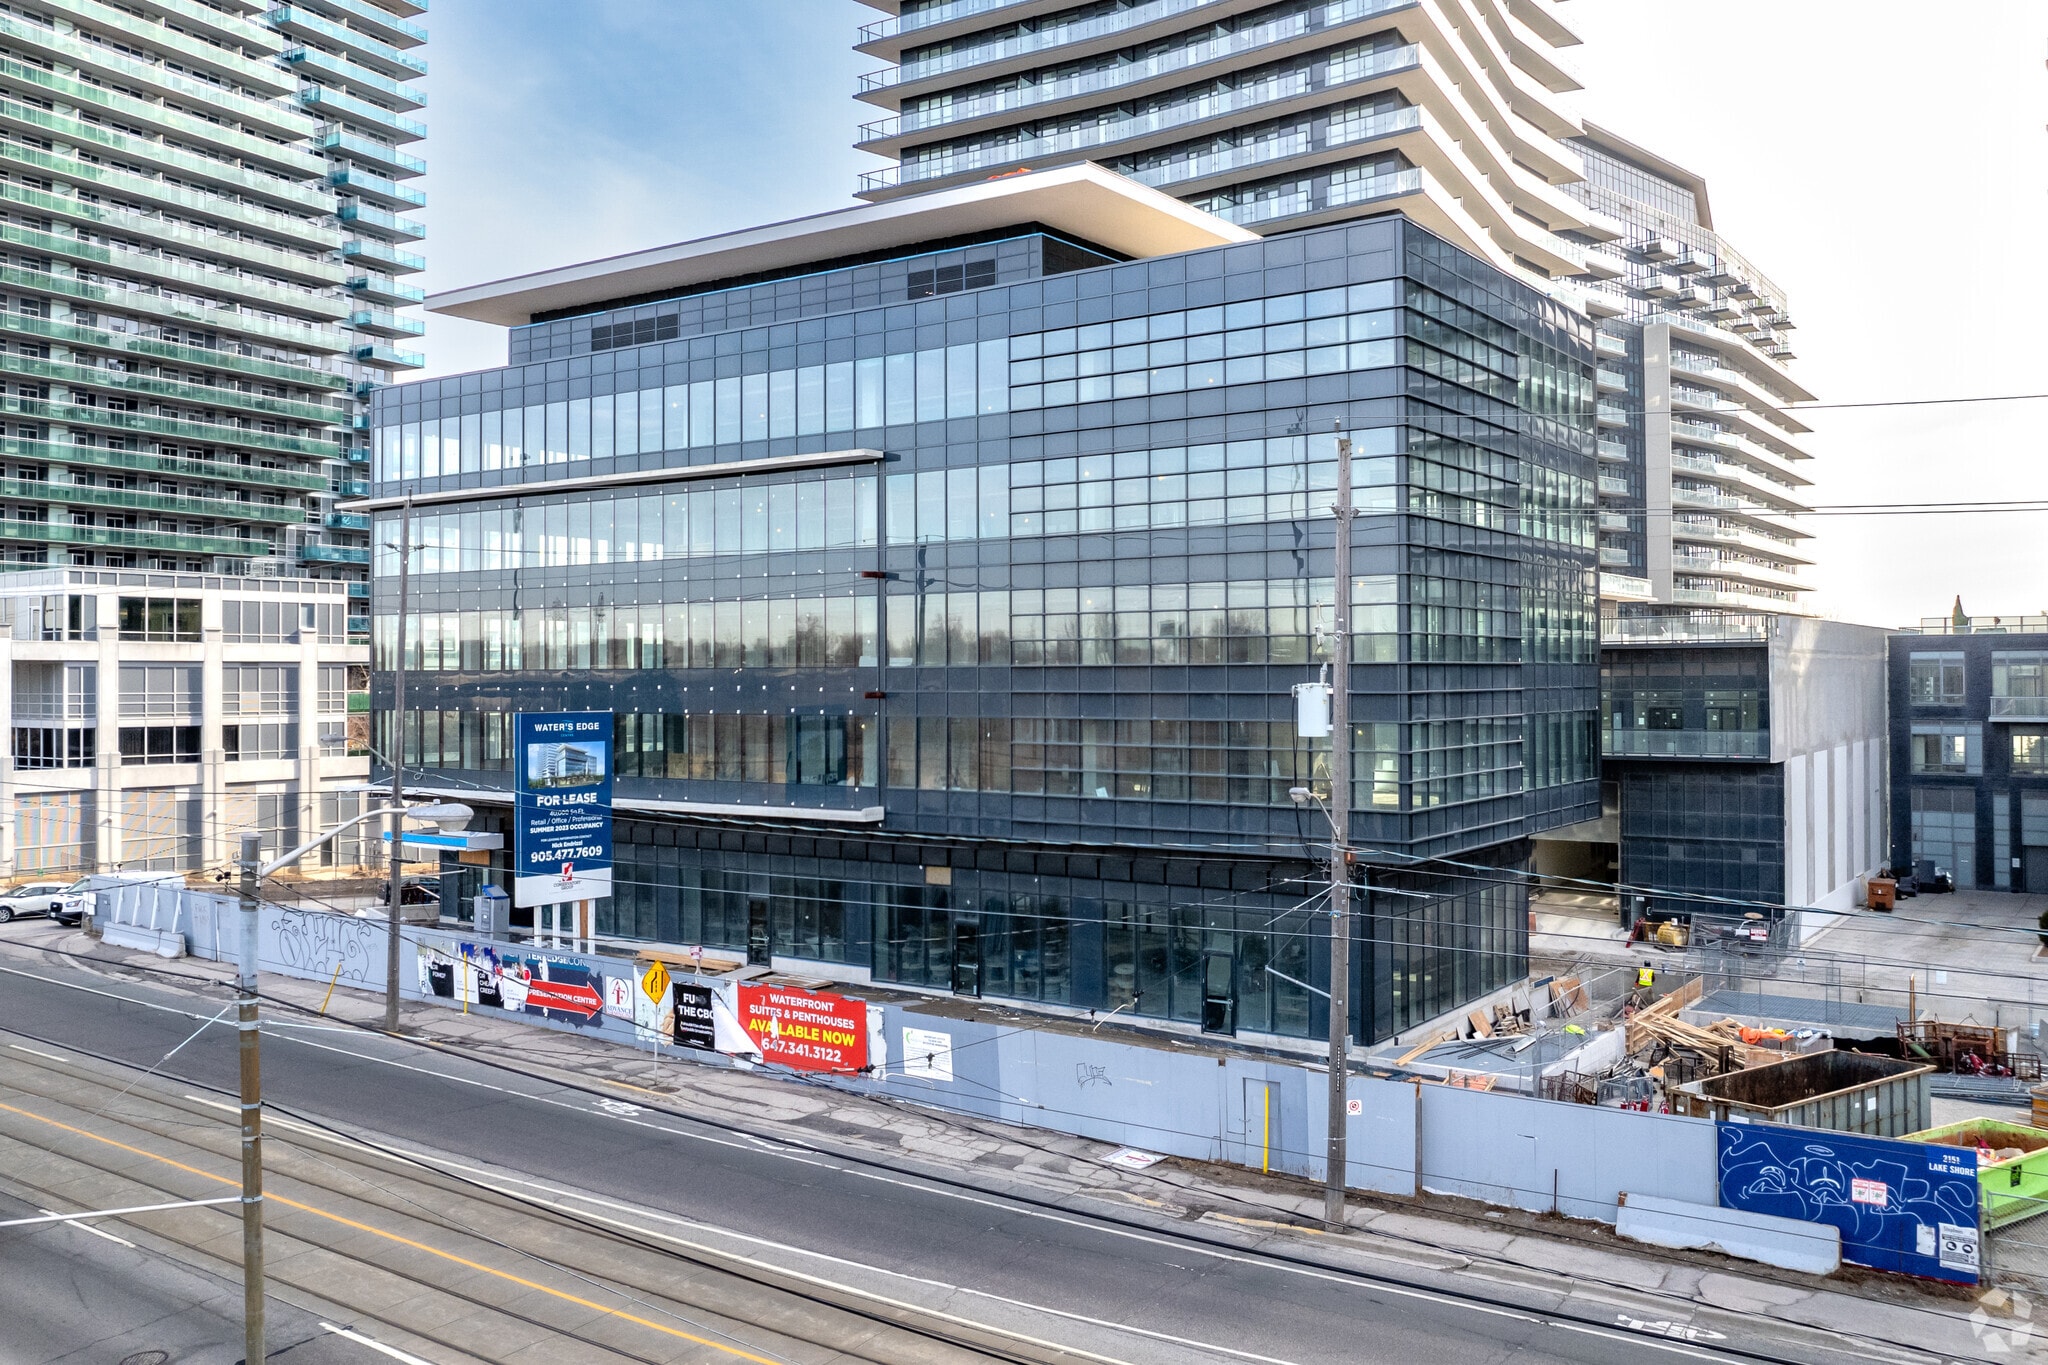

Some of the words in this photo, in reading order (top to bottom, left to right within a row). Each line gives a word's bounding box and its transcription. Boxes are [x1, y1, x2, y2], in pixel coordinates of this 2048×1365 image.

[534, 722, 574, 732] WATER'S
[576, 722, 600, 731] EDGE
[536, 795, 560, 807] FOR
[562, 792, 598, 805] LEASE
[572, 814, 603, 822] Professional
[529, 825, 554, 834] SUMMER
[555, 824, 569, 832] 2023
[570, 821, 604, 830] OCCUPANCY
[530, 845, 603, 863] 905.477.7609
[528, 988, 572, 1001] PRESENTATION
[573, 995, 597, 1005] CENTRE
[769, 993, 834, 1012] WATERFRONT
[678, 1004, 697, 1017] THE
[749, 1004, 782, 1018] SUITES
[783, 1009, 791, 1019] &
[792, 1010, 855, 1030] PENTHOUSES
[749, 1018, 820, 1041] AVALABLE
[822, 1030, 855, 1047] NOW
[762, 1037, 842, 1063] 647.341.3122
[1942, 1154, 1960, 1165] 2151
[1928, 1162, 1949, 1173] LAKE
[1950, 1165, 1976, 1177] SHORE
